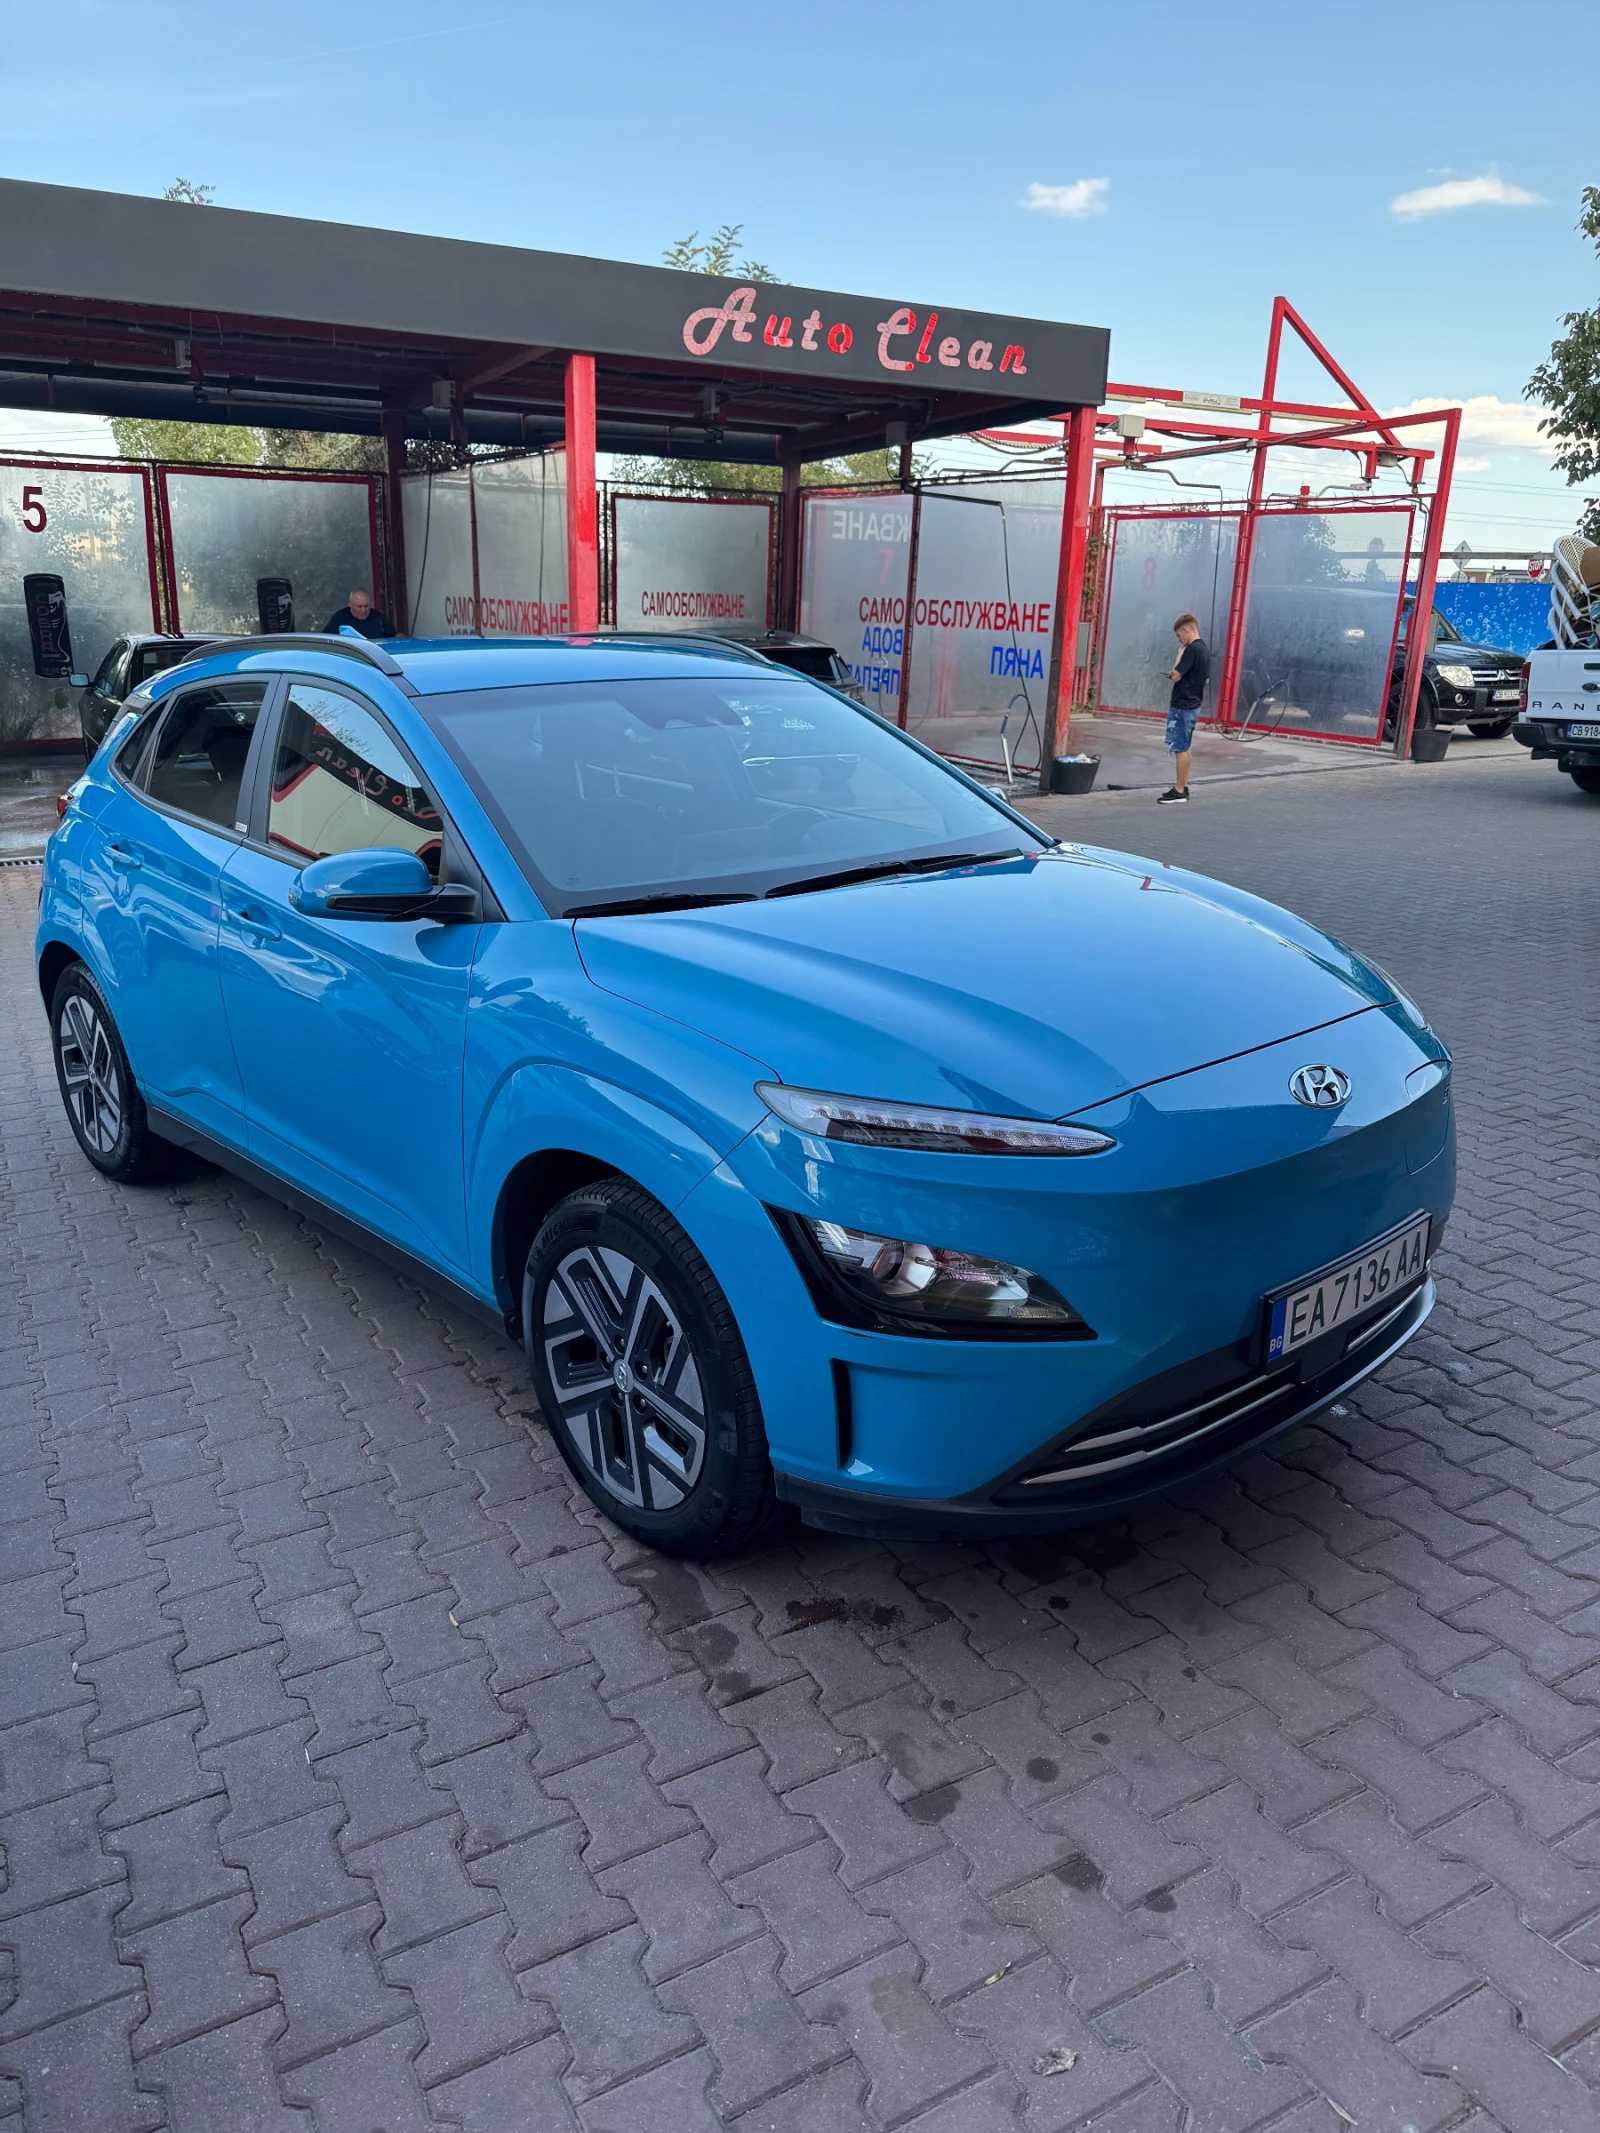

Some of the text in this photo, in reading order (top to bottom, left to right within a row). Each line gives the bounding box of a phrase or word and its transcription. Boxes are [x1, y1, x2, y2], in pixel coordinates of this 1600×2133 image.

[683, 287, 1027, 375] Auto Clean
[22, 486, 47, 533] 5
[1529, 560, 1543, 571] STOP
[641, 591, 745, 618] САМООБСЛУЖВАНЕ
[1572, 725, 1600, 737] CB 918
[1289, 1230, 1421, 1344] EA 7136 AA
[1270, 1335, 1283, 1353] BG
